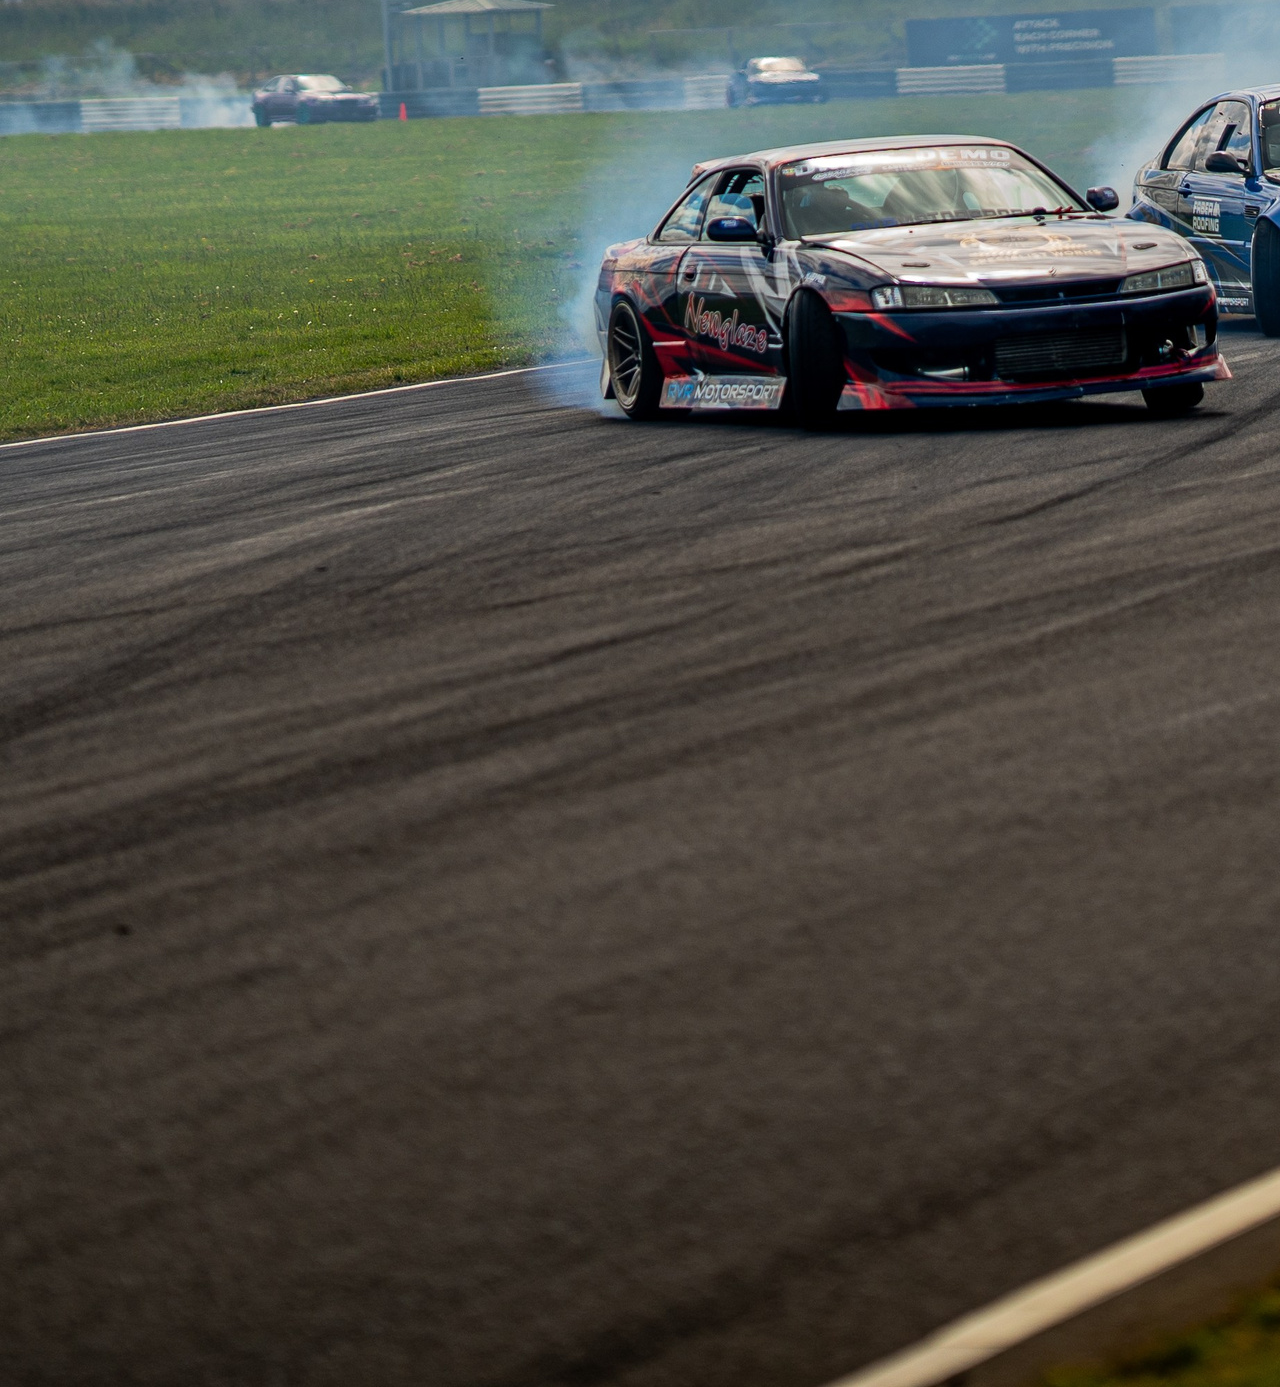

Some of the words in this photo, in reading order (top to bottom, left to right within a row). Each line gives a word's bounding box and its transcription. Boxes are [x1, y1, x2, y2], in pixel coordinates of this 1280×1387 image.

[914, 149, 1011, 161] DEMO
[683, 291, 767, 353] Newglaze
[667, 384, 694, 399] RVR
[694, 384, 779, 400] MOTORSPORT
